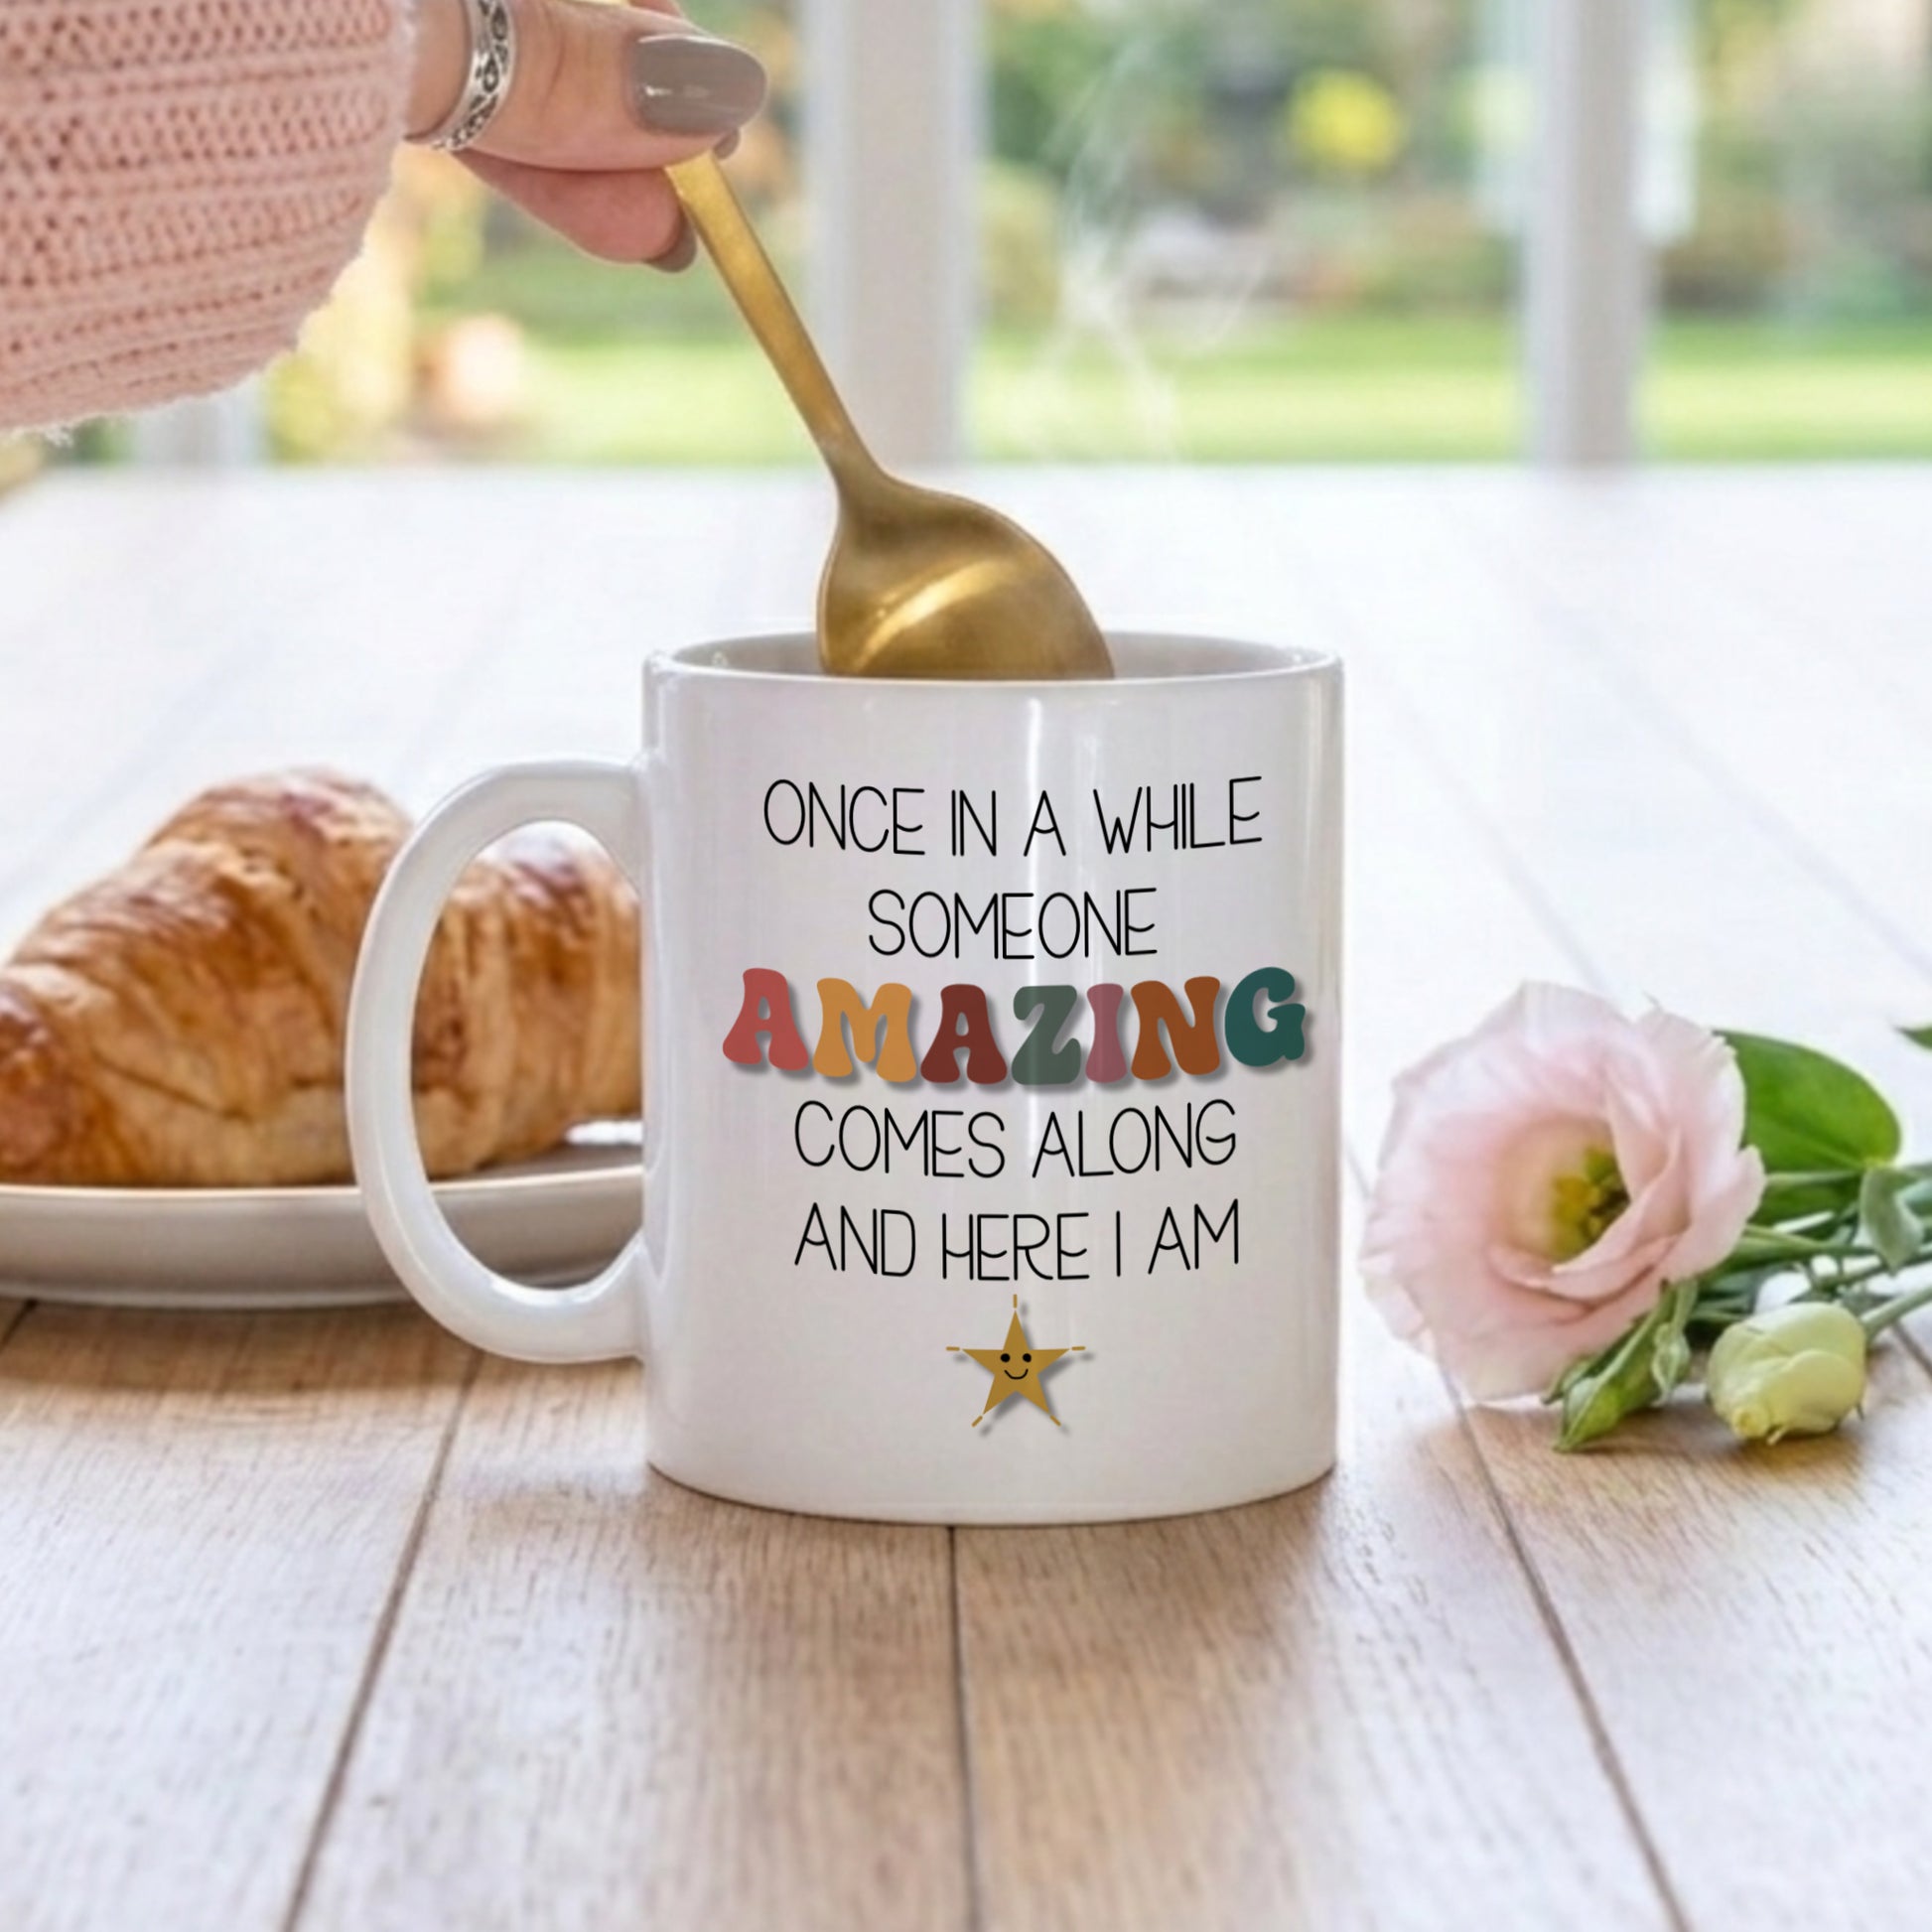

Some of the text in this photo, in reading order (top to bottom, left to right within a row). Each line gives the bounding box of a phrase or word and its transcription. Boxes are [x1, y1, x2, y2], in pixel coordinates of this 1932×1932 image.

[763, 775, 1263, 858] ONCE IN A WHILE
[868, 888, 1158, 960] SOMEONE
[722, 966, 1306, 1085] AMAZING
[794, 1098, 1236, 1178] COMES ALONG
[793, 1198, 1239, 1282] AND HERE I AM
